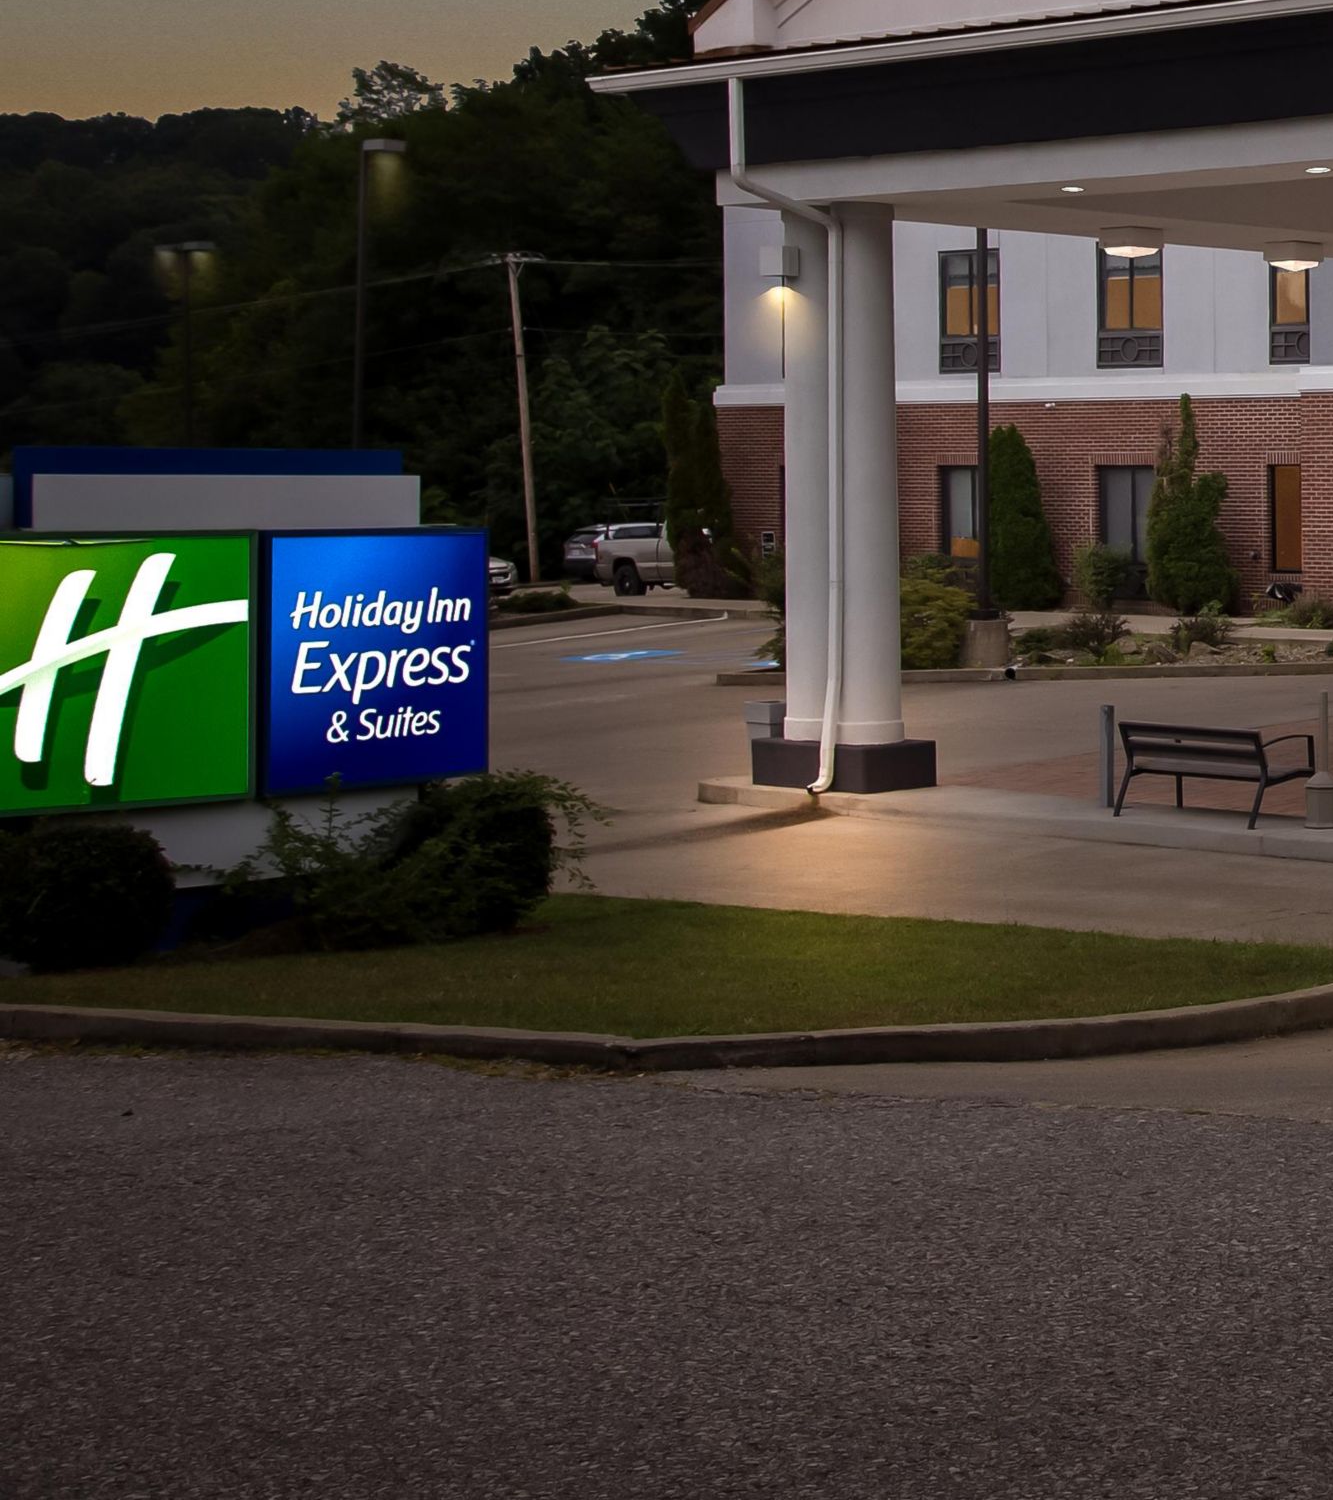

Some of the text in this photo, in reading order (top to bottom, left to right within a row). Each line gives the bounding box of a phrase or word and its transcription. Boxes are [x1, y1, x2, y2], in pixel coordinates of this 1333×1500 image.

[290, 587, 471, 634] Holiday Inn
[291, 641, 471, 705] Express
[326, 706, 441, 743] & Suites
